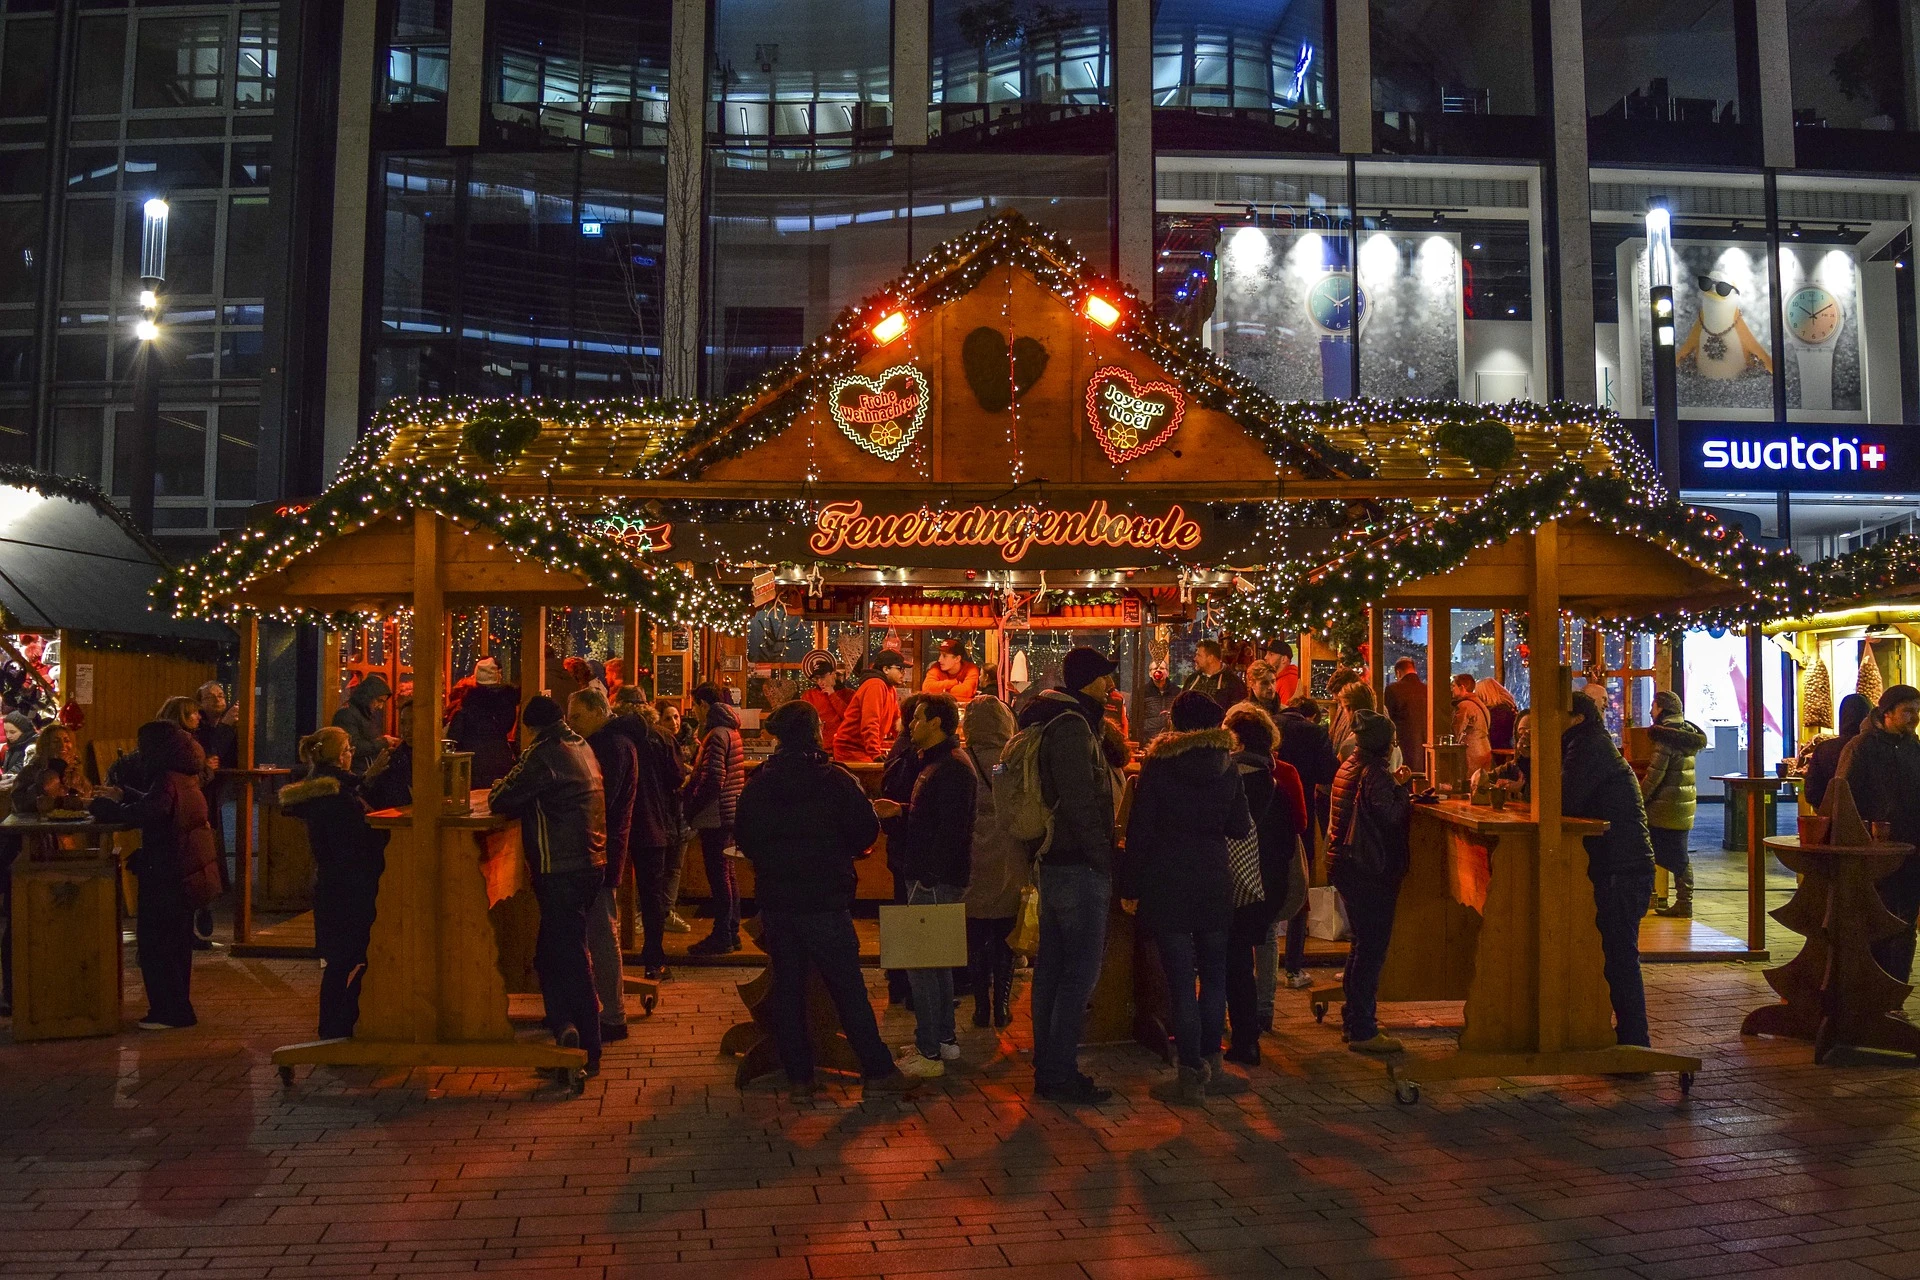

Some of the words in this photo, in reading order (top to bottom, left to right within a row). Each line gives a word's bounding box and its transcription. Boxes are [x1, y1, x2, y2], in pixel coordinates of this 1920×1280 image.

[840, 393, 919, 423] Weihnachten
[859, 391, 898, 410] Frohe
[1105, 384, 1165, 416] Joyeux
[1109, 404, 1152, 430] Noël
[1702, 436, 1858, 471] swatch
[810, 500, 1202, 563] Feuerzangenbowle
